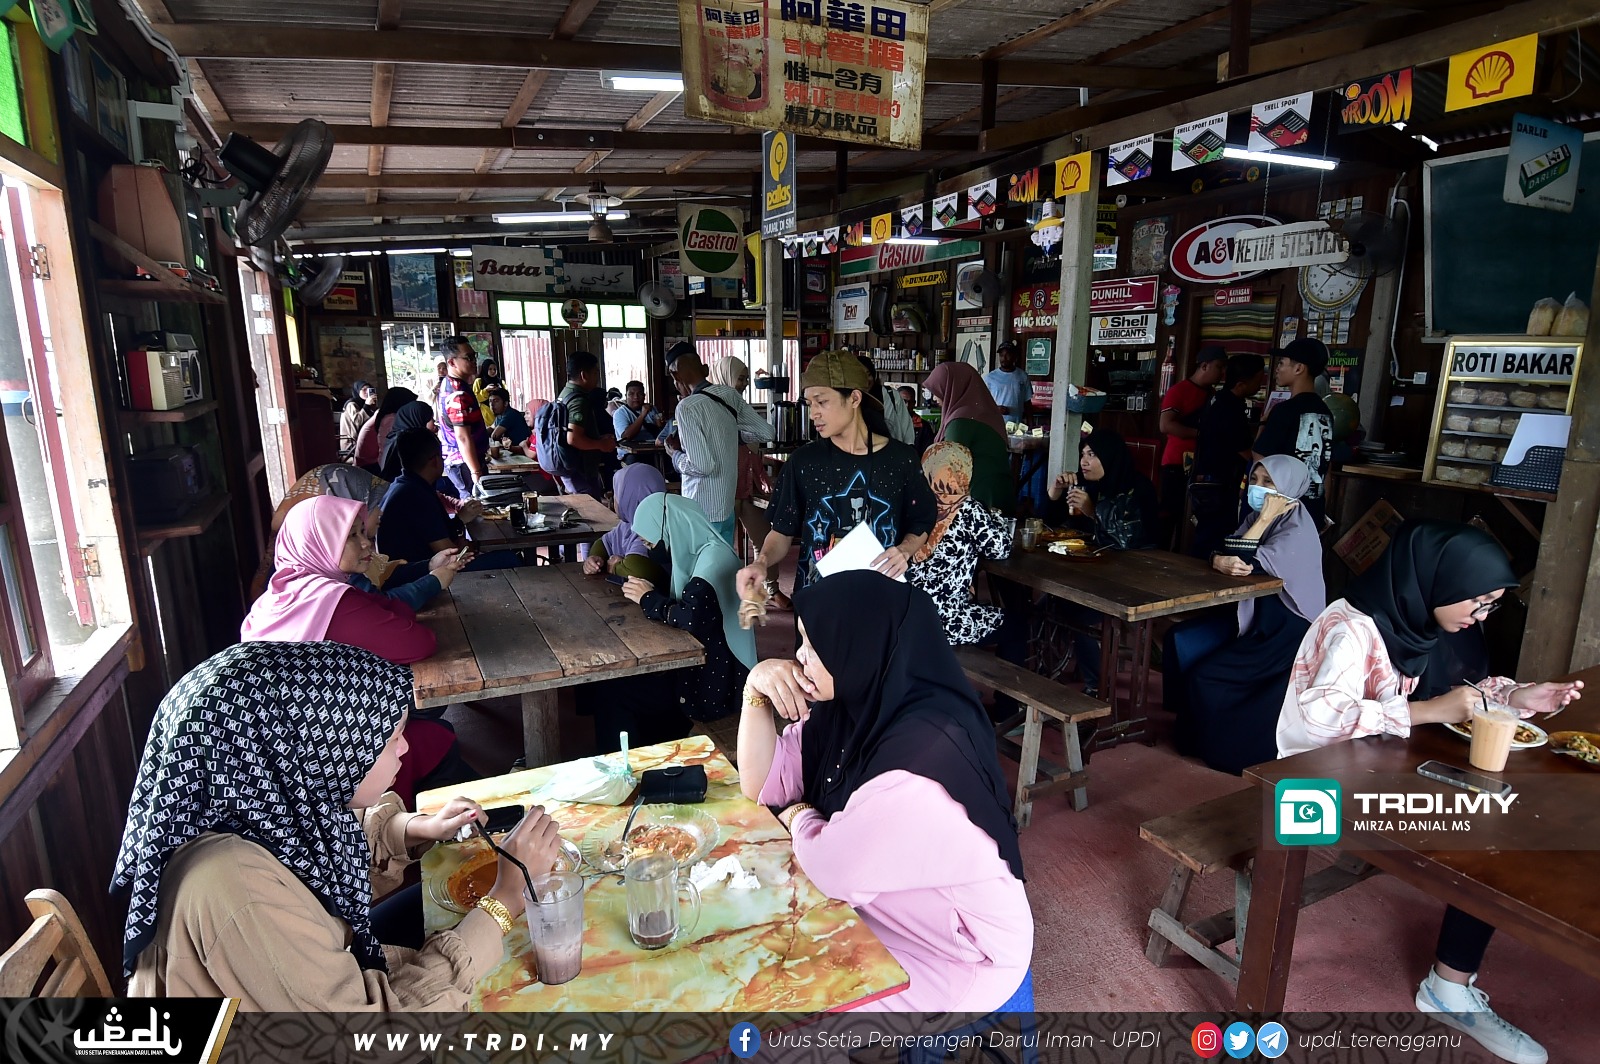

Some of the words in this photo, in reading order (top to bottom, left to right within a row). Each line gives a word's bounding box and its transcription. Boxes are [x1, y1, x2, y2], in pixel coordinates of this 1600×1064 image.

[780, 0, 906, 41] 阿華田
[1264, 103, 1279, 112] SHELL
[1281, 97, 1299, 108] SPORT
[1341, 68, 1412, 125] VROOM
[1191, 121, 1207, 131] SPORT
[1208, 116, 1224, 126] EXTRA
[1516, 122, 1548, 138] DARLIE
[1528, 167, 1559, 189] DARLIE
[688, 231, 738, 251] Castrol
[878, 243, 925, 270] Castrol
[1235, 237, 1275, 263] KETUA
[476, 259, 542, 277] Bata
[908, 274, 939, 284] DUNLOP
[1091, 287, 1132, 300] DUNHILL
[1013, 317, 1034, 328] FUNG
[1111, 315, 1149, 327] Shell
[1098, 329, 1147, 338] LUBRICANTS
[1453, 352, 1497, 373] ROTI
[1502, 353, 1575, 375] BAKAR
